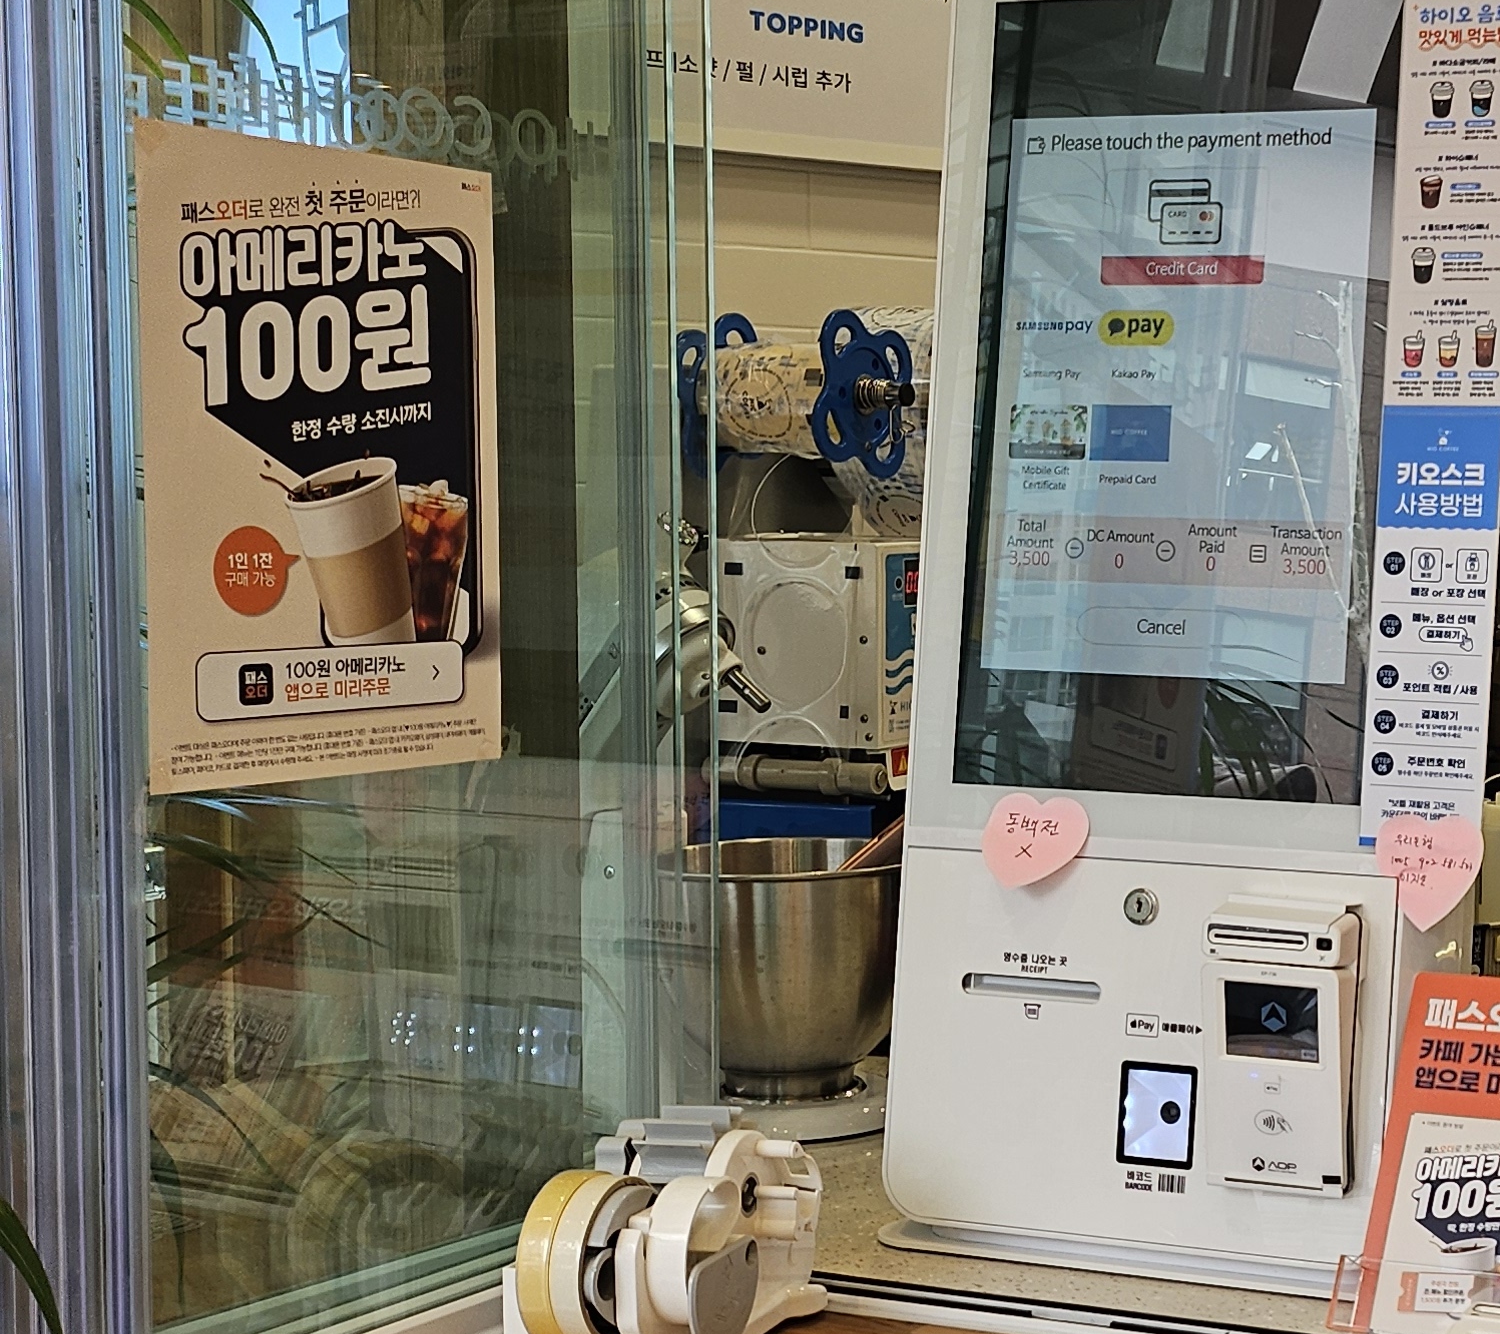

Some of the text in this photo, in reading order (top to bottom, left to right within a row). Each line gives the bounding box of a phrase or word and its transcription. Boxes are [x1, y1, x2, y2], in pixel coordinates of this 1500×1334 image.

[749, 9, 864, 44] TOPPING
[1419, 8, 1473, 25] 하이오
[1418, 29, 1463, 45] 맛있게
[736, 59, 852, 93] 펄 시럽 추가
[1050, 128, 1332, 153] Please touch the payment method
[181, 199, 265, 223] 패스오더로
[269, 199, 300, 218] 완전
[304, 189, 323, 215] 첫
[181, 219, 427, 297] 아메리카노
[1146, 260, 1217, 276] Credit Card
[1126, 314, 1165, 338] pay
[184, 283, 432, 407] 100원
[1111, 368, 1156, 381] Kakao Pay
[292, 405, 432, 441] 한정 수량 소진시까지
[1397, 462, 1485, 487] 키오스크
[1395, 493, 1483, 516] 사용방법
[1271, 526, 1342, 540] Transaction
[228, 553, 272, 569] 1인 1잔
[1283, 559, 1326, 575] 3,500
[225, 571, 275, 588] 구매 가능
[1136, 619, 1186, 635] Cancel
[285, 678, 391, 702] 앱으로 미리주문
[1005, 812, 1060, 838] 동백전
[1031, 953, 1056, 966] 나오는
[1420, 1039, 1462, 1064] 카페
[1415, 1066, 1479, 1093] 앱으로
[1126, 1172, 1152, 1183] 바코드
